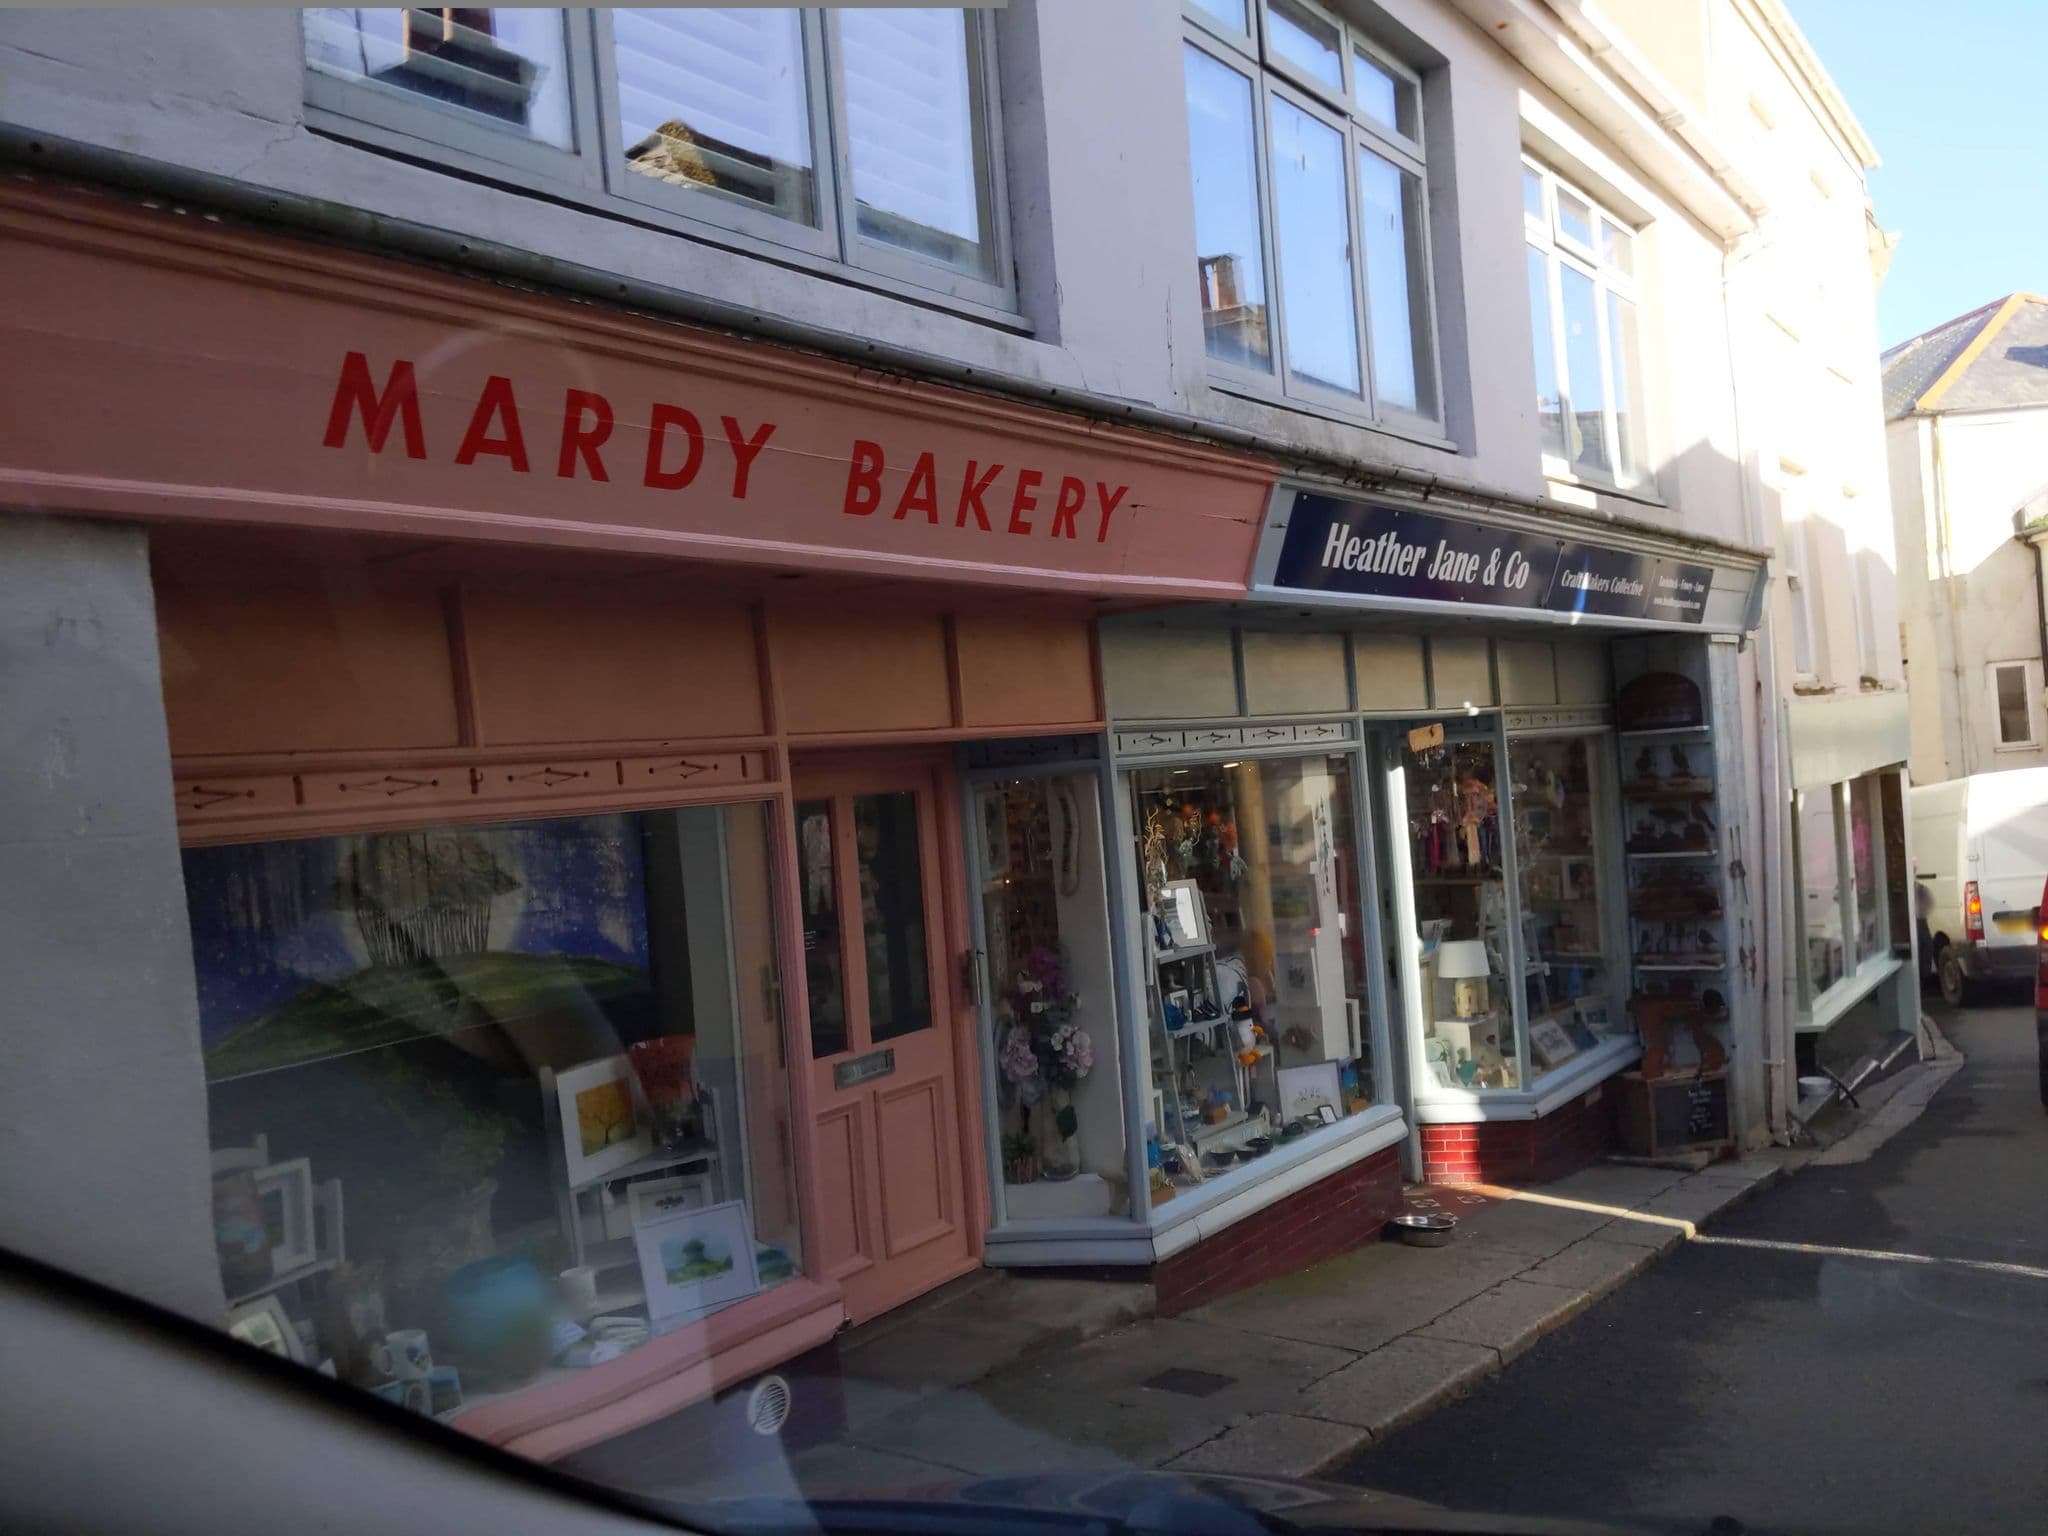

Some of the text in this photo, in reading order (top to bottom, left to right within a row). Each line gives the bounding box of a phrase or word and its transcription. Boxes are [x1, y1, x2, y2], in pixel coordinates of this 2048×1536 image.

[323, 351, 1129, 543] MARDY BAKERY
[1321, 522, 1530, 590] Heather Jane & Co
[1561, 569, 1583, 589] Craft
[1610, 576, 1644, 597] Collective
